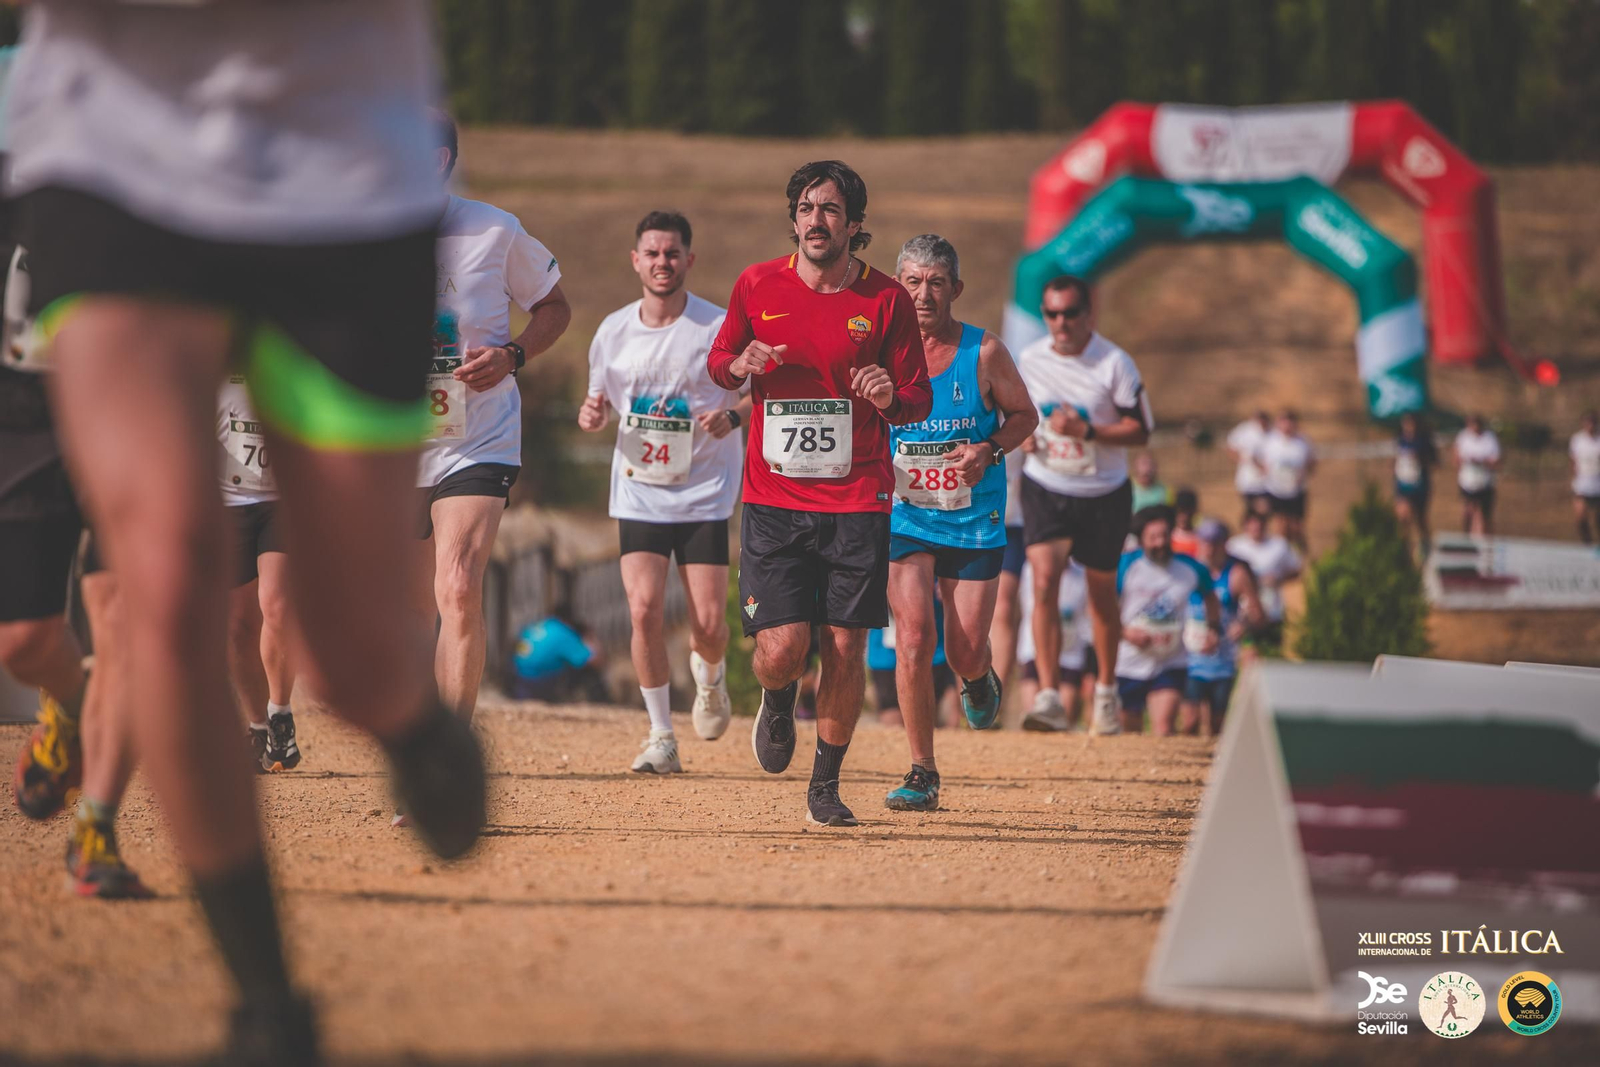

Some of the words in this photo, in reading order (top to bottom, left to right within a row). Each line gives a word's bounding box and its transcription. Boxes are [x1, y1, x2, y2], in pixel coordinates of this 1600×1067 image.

[789, 402, 828, 413] ITÁLICA
[781, 427, 836, 453] 785
[912, 444, 950, 454] ITÁLICA
[641, 441, 670, 465] 24
[908, 468, 959, 491] 288
